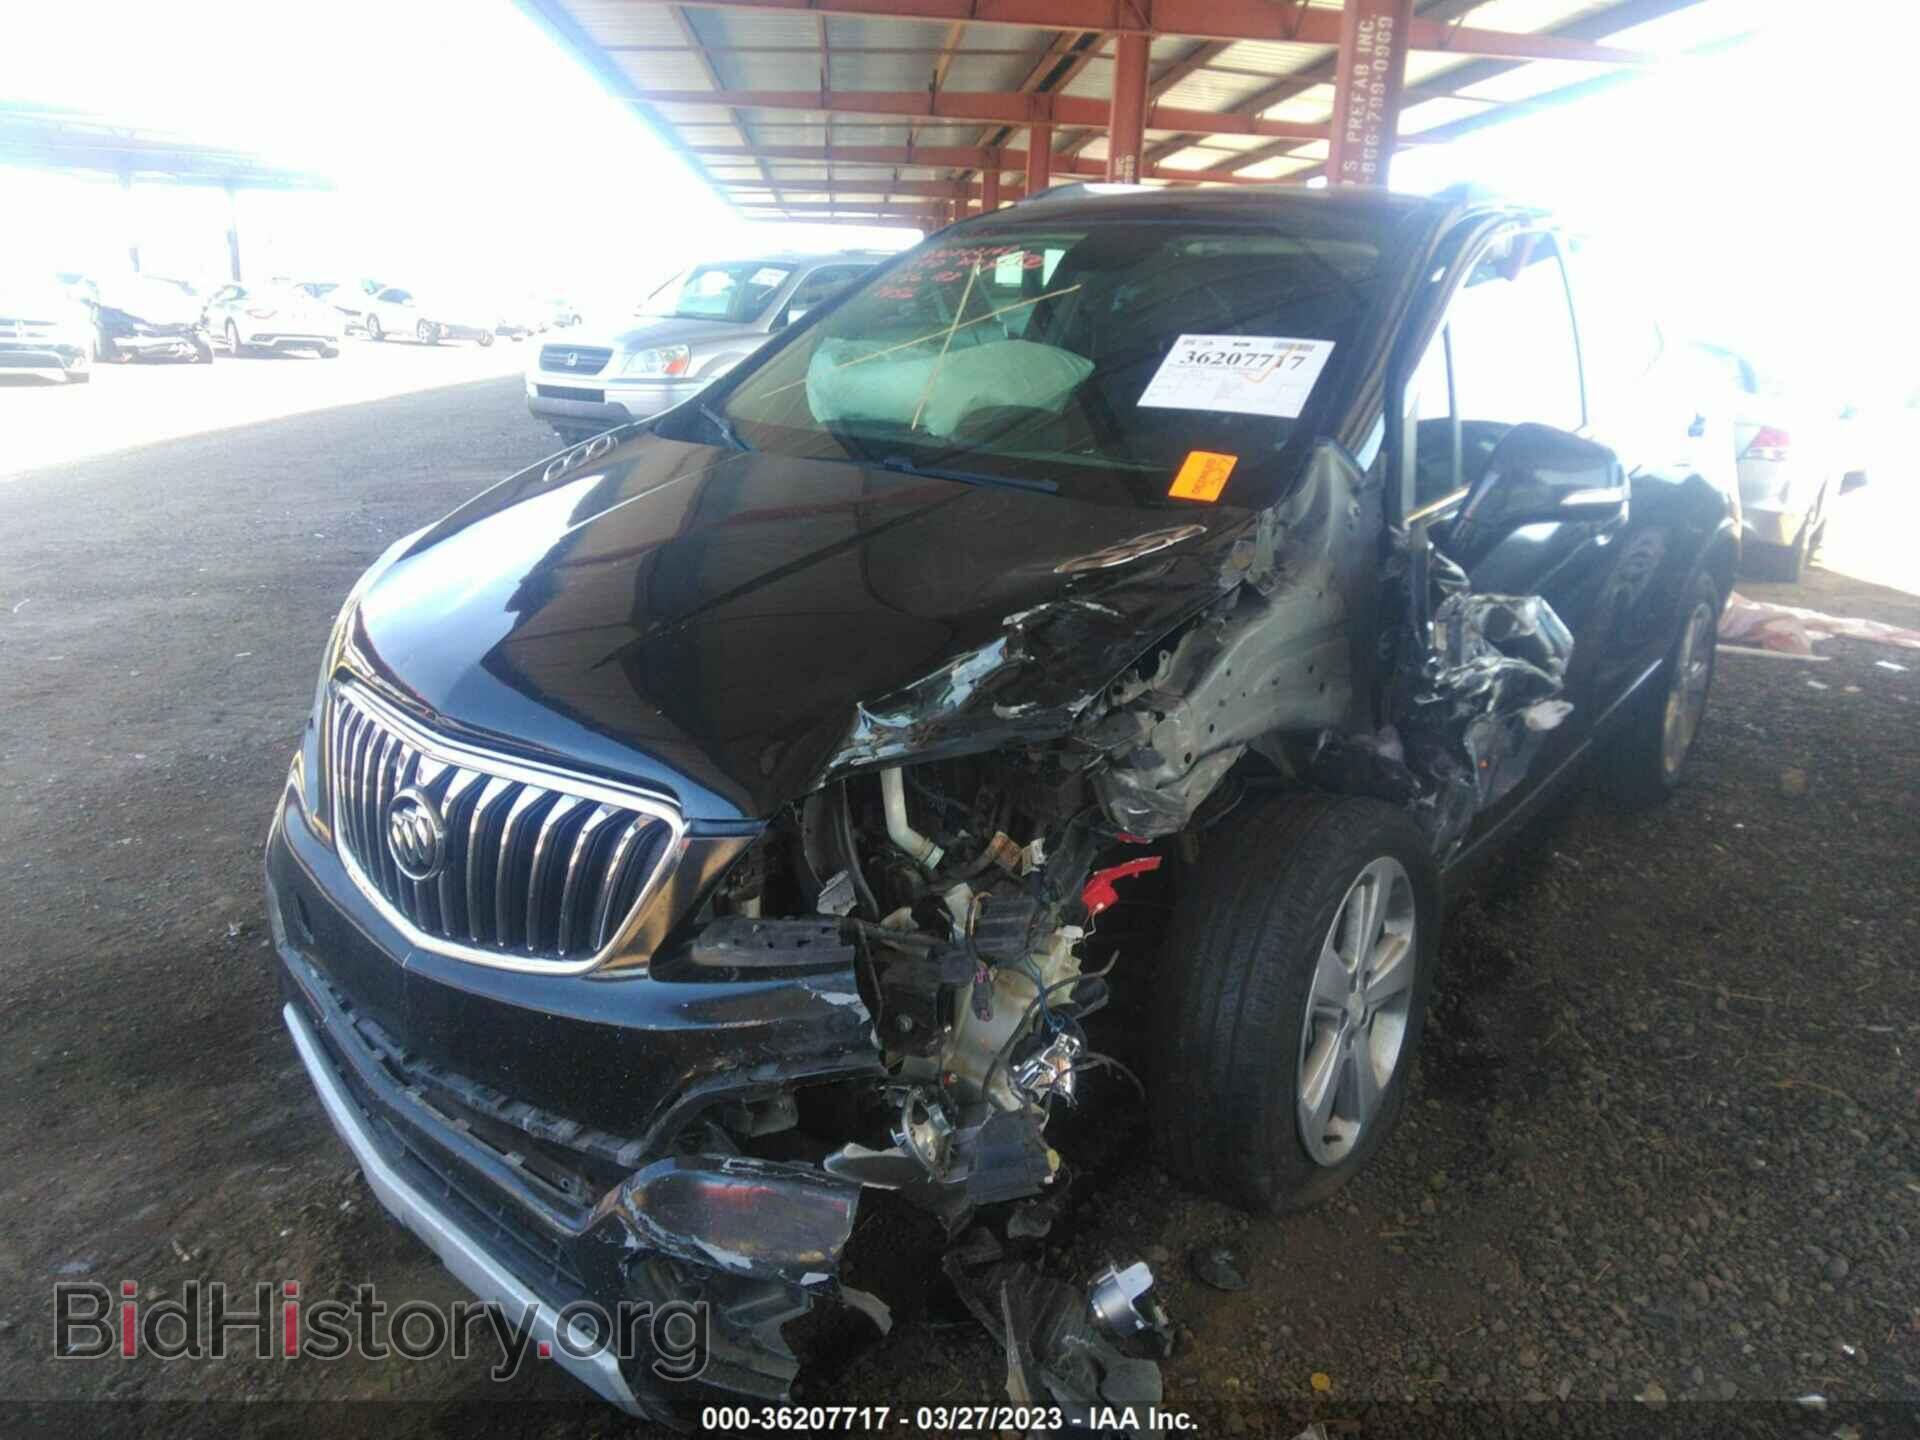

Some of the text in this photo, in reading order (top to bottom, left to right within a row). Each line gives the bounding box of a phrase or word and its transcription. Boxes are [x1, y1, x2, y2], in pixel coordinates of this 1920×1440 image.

[1357, 14, 1377, 53] INC.
[1347, 63, 1370, 143] PREFAB
[1179, 350, 1306, 370] 36207717
